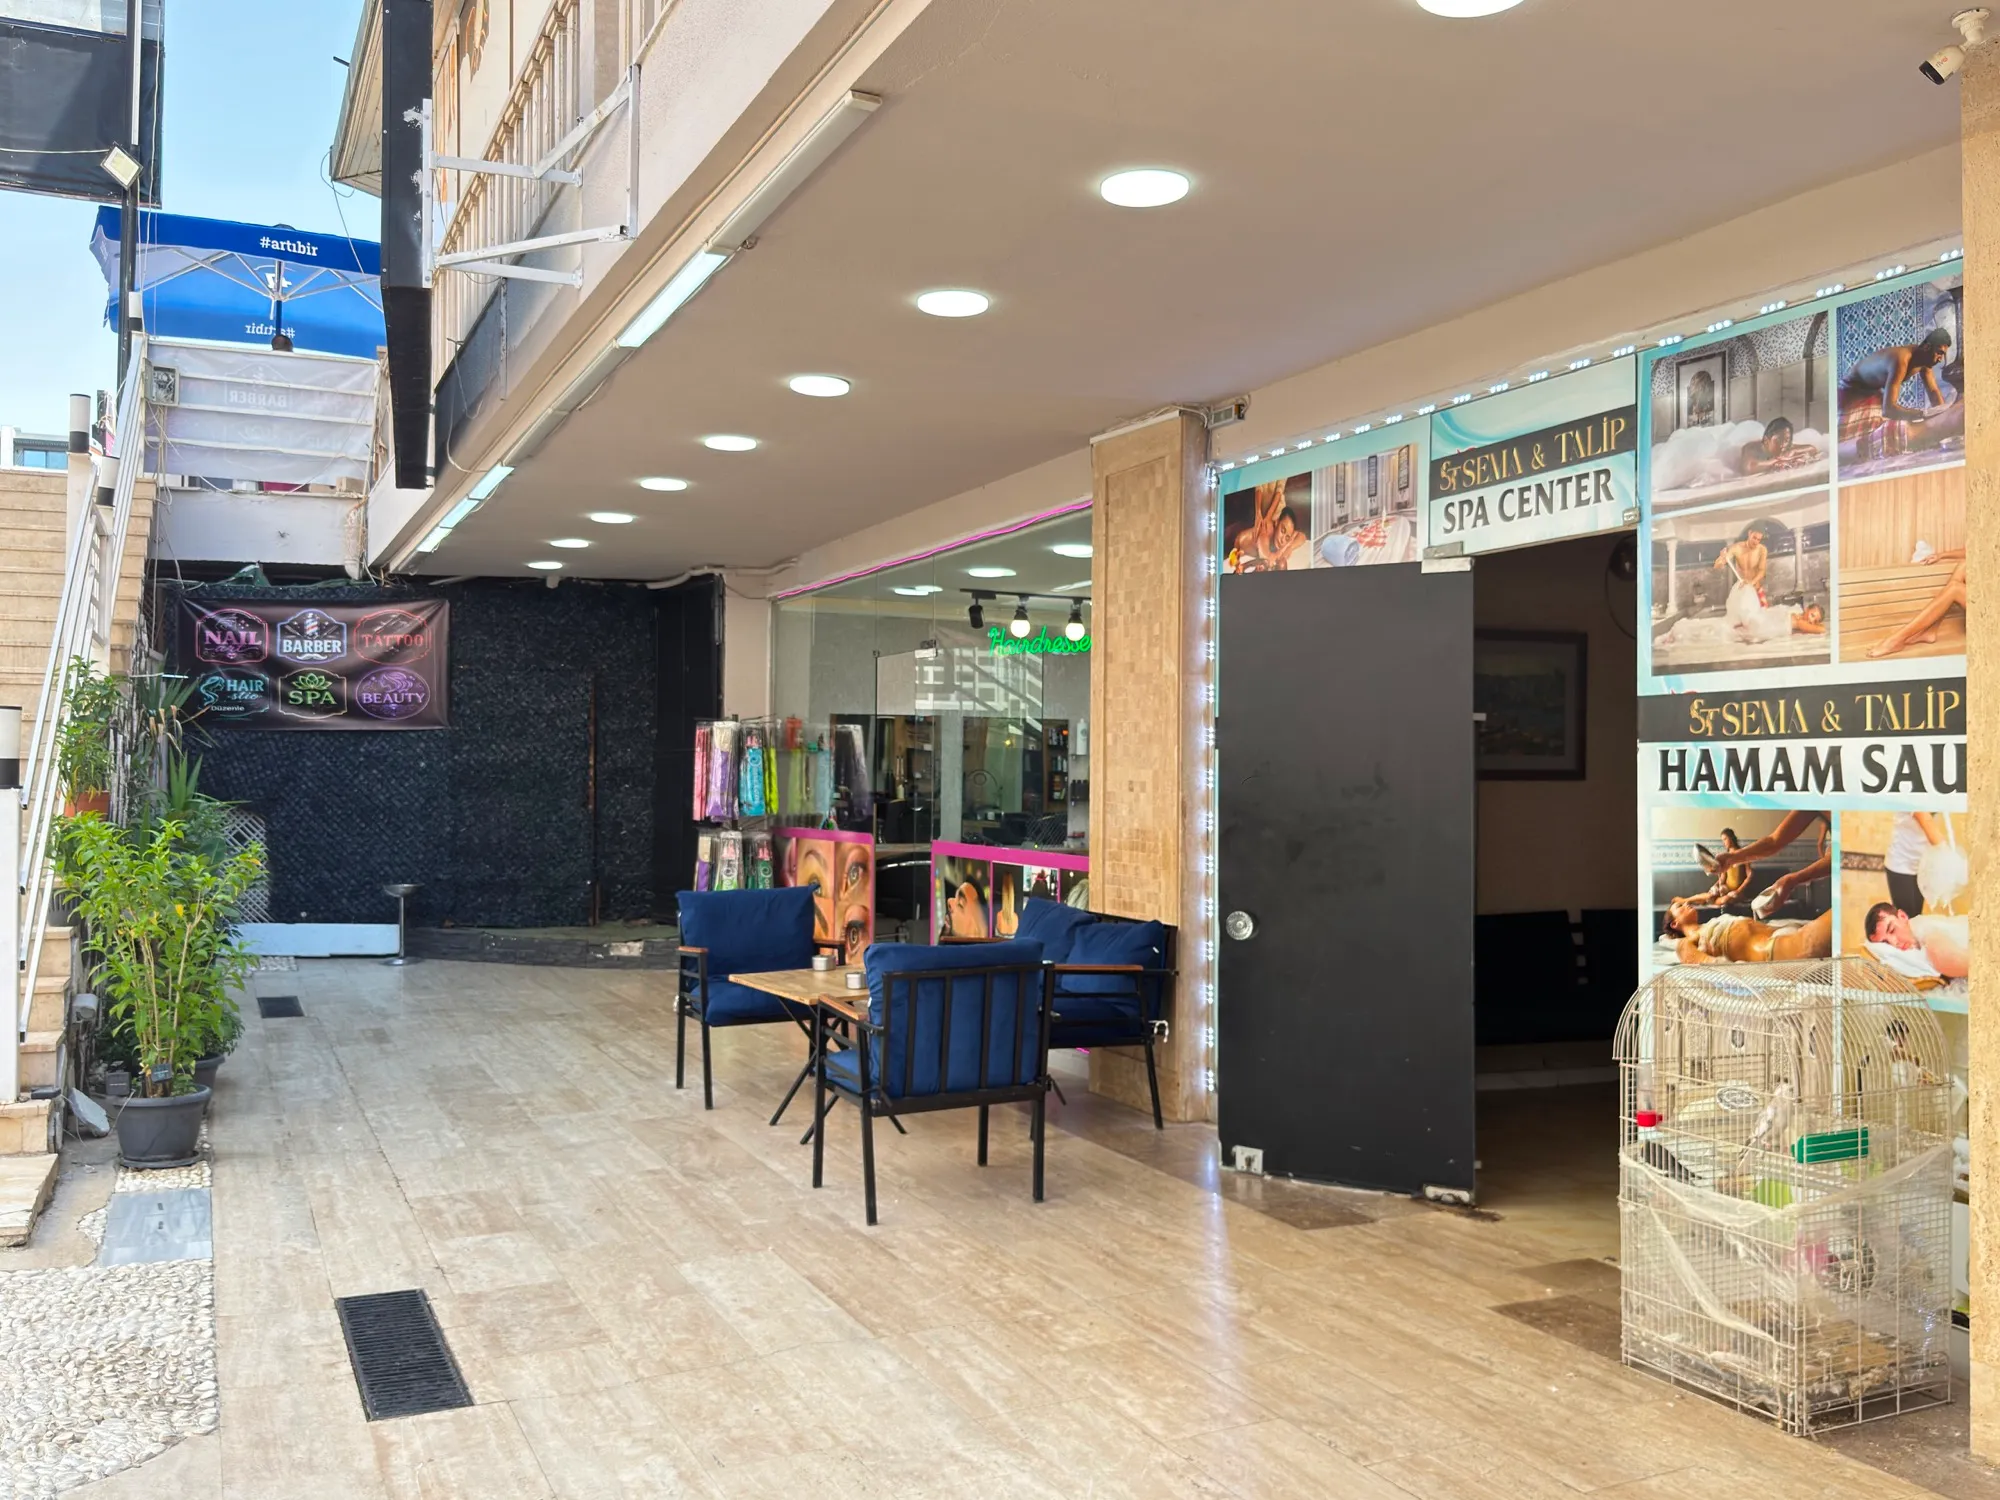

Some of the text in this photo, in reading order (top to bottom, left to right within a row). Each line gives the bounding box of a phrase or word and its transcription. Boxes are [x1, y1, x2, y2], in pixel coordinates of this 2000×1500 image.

[260, 236, 318, 257] #artıbir
[1530, 443, 1548, 471] &
[1443, 467, 1615, 535] SPA CENTER
[204, 630, 262, 646] NAIL
[282, 639, 342, 653] BARBER
[361, 634, 425, 648] TATTOO
[226, 679, 265, 692] HAIR
[288, 690, 337, 705] SPA
[362, 692, 426, 704] BEAUTY
[1820, 699, 1842, 733] &
[1658, 742, 1967, 795] HAMAM SAU
